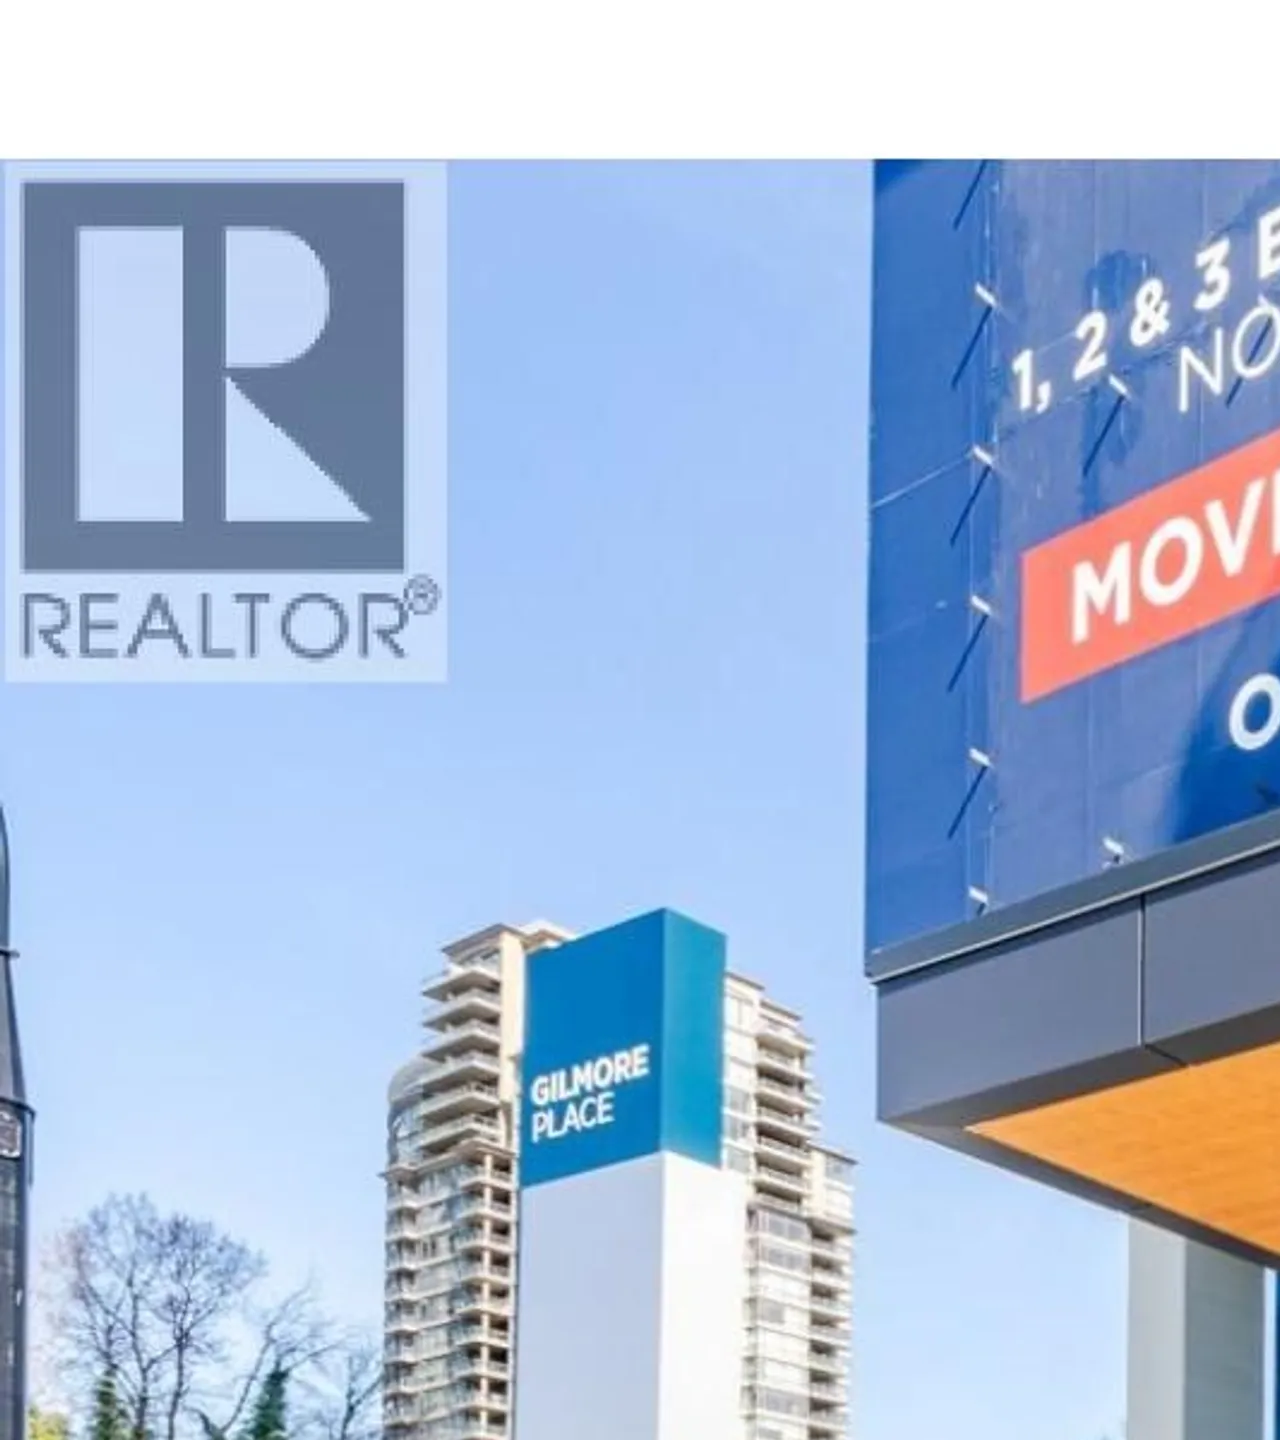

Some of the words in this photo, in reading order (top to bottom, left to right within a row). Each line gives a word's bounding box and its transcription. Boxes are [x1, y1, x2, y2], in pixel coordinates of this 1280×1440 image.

[1011, 349, 1051, 413] 1,
[1072, 311, 1107, 381] 2
[1130, 278, 1170, 346] &
[1194, 237, 1231, 310] 3
[531, 1043, 650, 1105] GILMORE
[532, 1091, 615, 1143] PLACE
